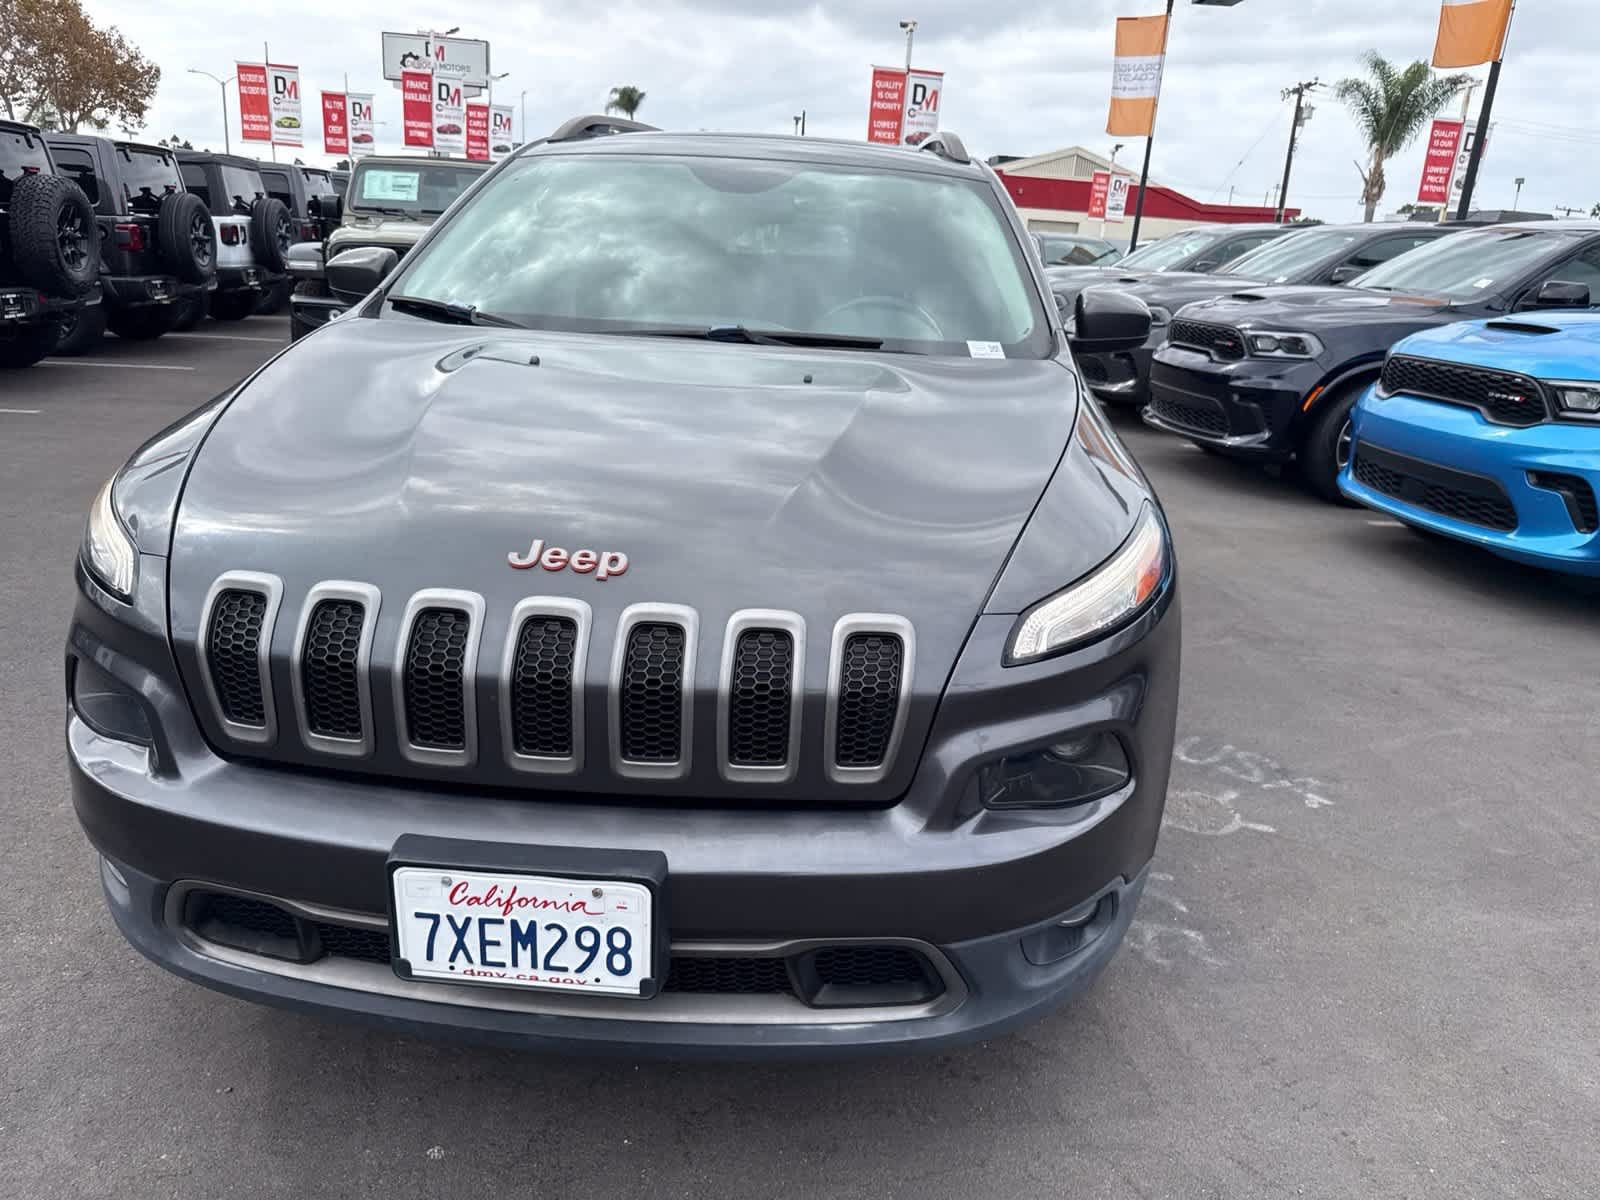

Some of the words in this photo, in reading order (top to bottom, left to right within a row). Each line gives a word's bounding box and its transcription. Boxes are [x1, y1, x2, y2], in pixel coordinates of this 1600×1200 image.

[440, 63, 471, 72] MOTORS
[274, 75, 298, 100] DM
[406, 80, 428, 90] FINANCE
[875, 80, 903, 89] QUALITY
[405, 91, 432, 102] AVAILABLE
[438, 83, 461, 107] DM
[878, 91, 884, 99] IS
[885, 91, 899, 100] OUR
[912, 83, 939, 112] DM
[873, 101, 901, 110] PRIORITY
[352, 102, 371, 121] DM
[494, 112, 511, 131] DM
[873, 120, 898, 129] LOWEST
[874, 130, 895, 139] PRICES
[1433, 129, 1458, 138] QUALITY
[1433, 139, 1440, 147] IS
[1440, 139, 1453, 148] OUR
[1429, 149, 1454, 158] PRIORITY
[1427, 166, 1449, 174] LOWEST
[507, 539, 628, 581] Jeep
[449, 881, 604, 916] California
[414, 912, 632, 977] 7XEM298
